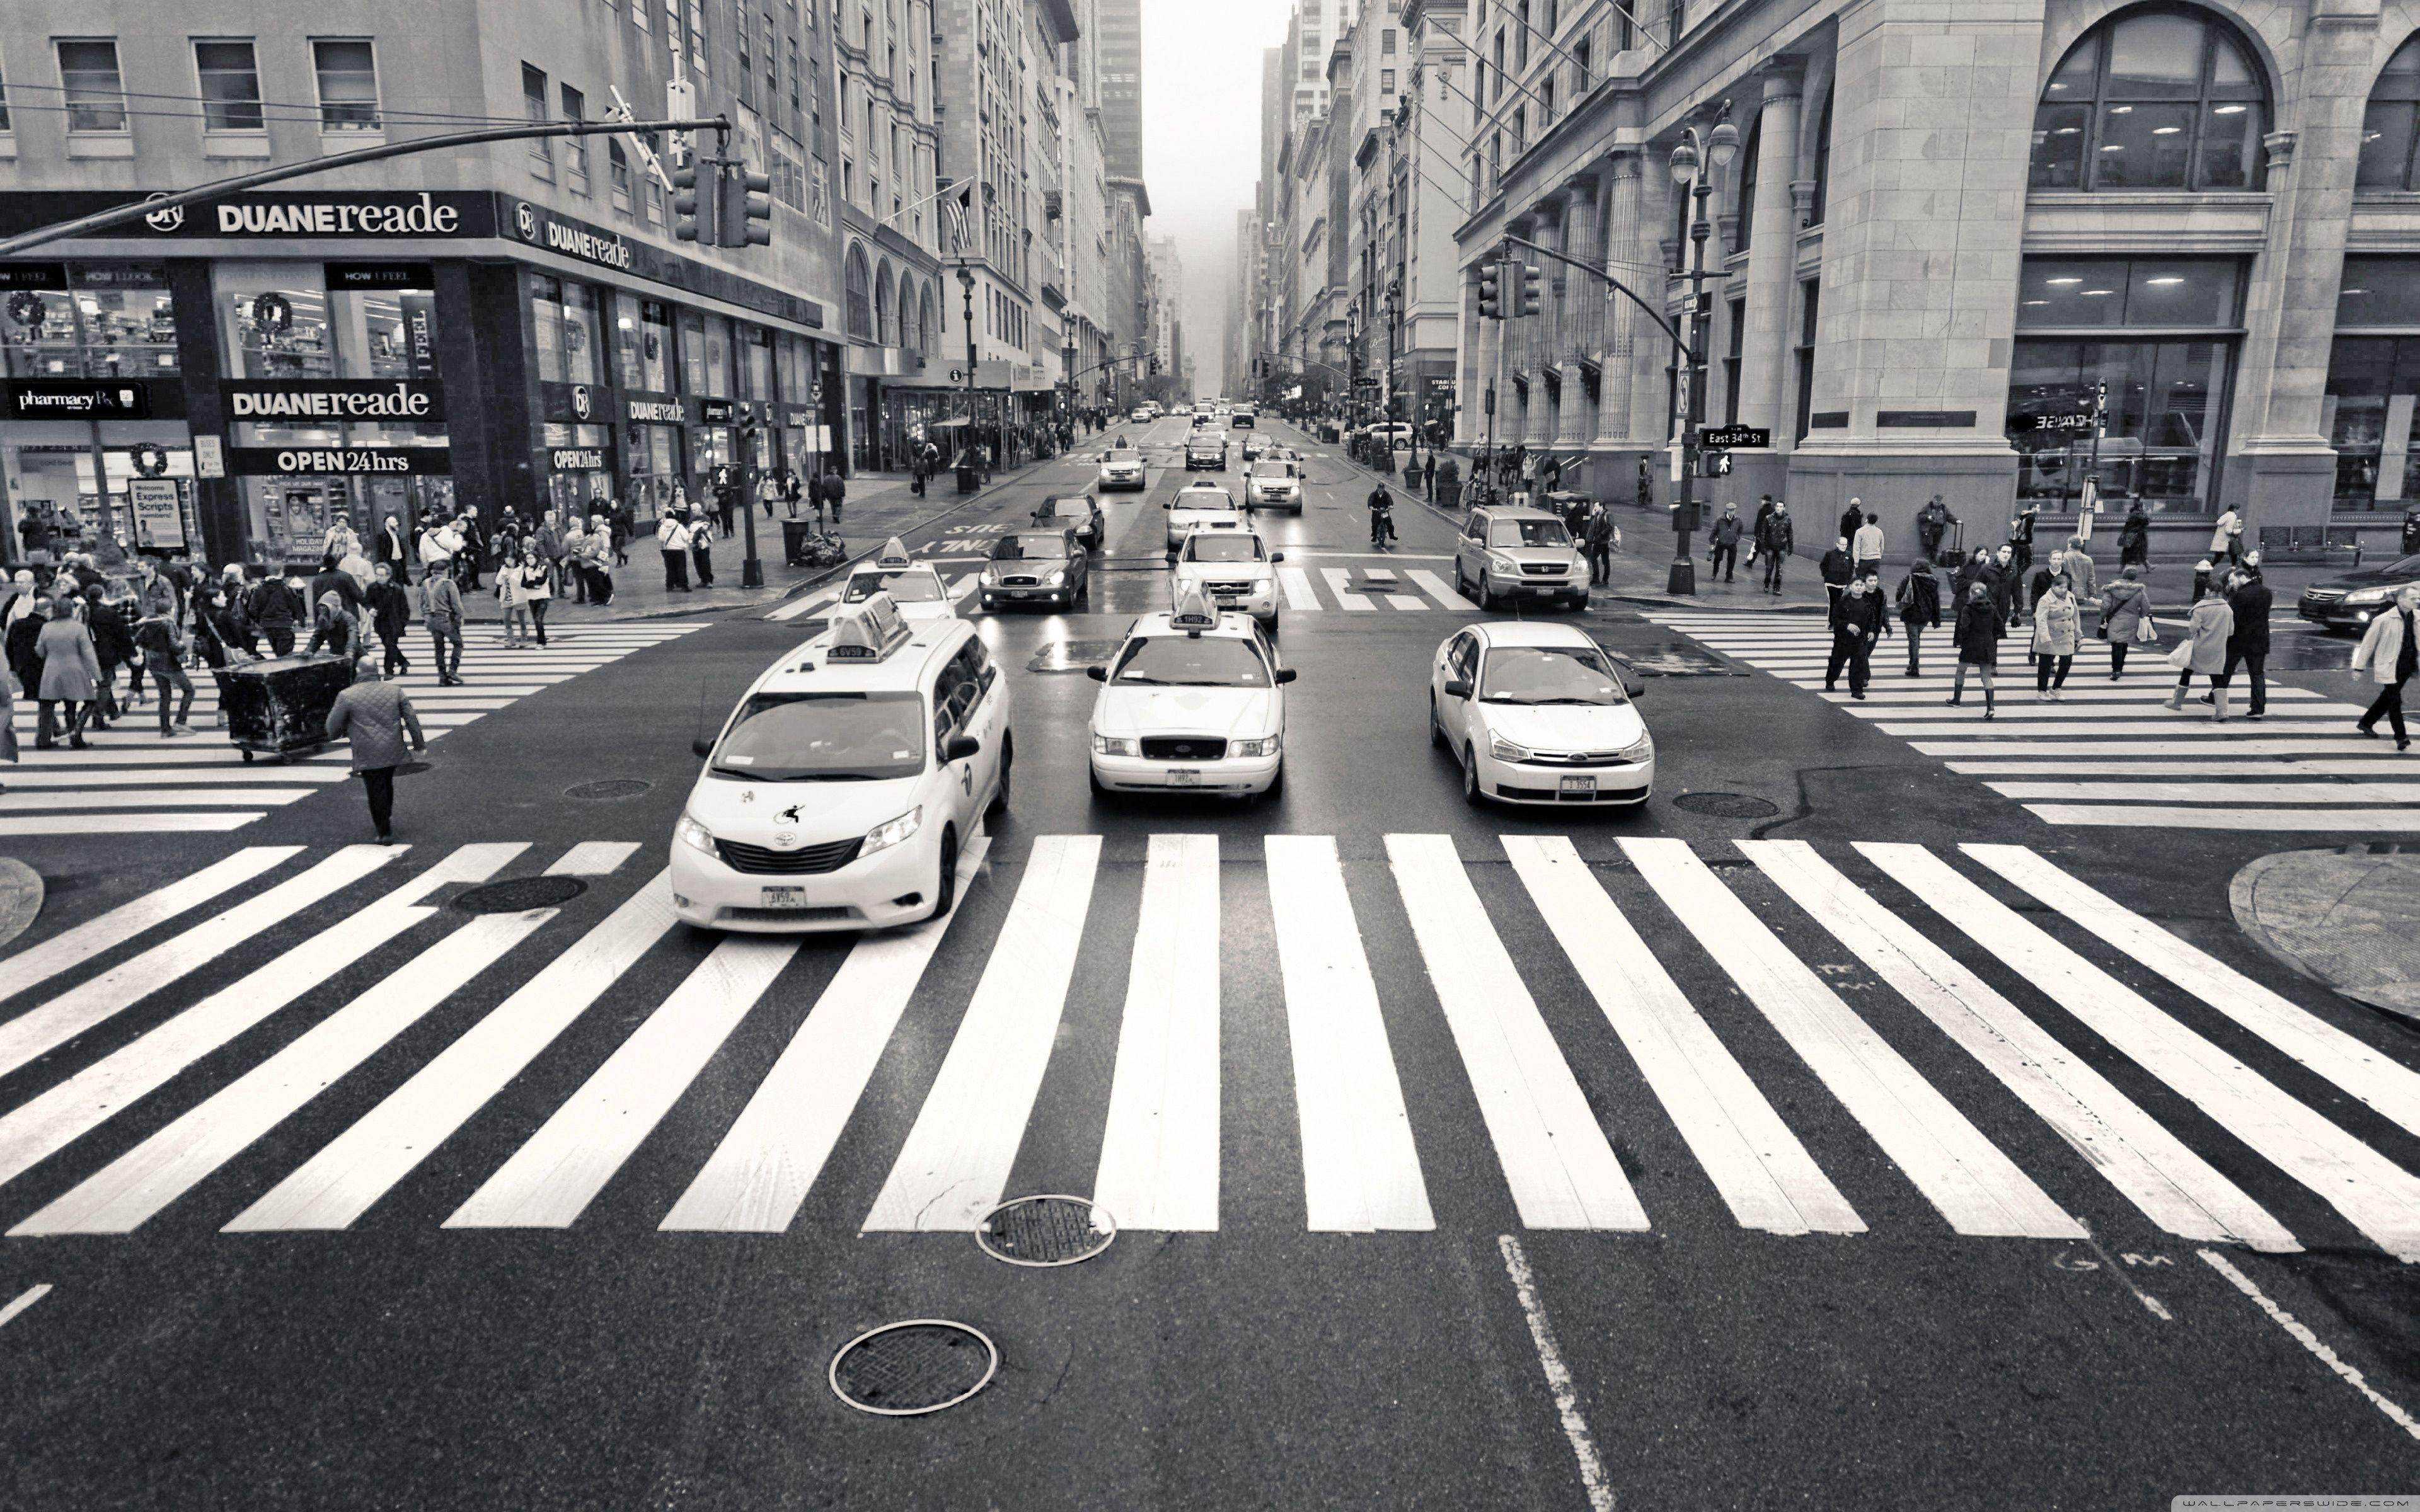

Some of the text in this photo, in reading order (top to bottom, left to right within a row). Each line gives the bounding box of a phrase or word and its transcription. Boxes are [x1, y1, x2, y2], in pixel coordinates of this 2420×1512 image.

[19, 390, 94, 410] pharmacy
[1709, 433, 1761, 443] East 34th St
[137, 492, 174, 501] Express
[137, 502, 173, 512] Scripts
[839, 647, 861, 656] 6V59
